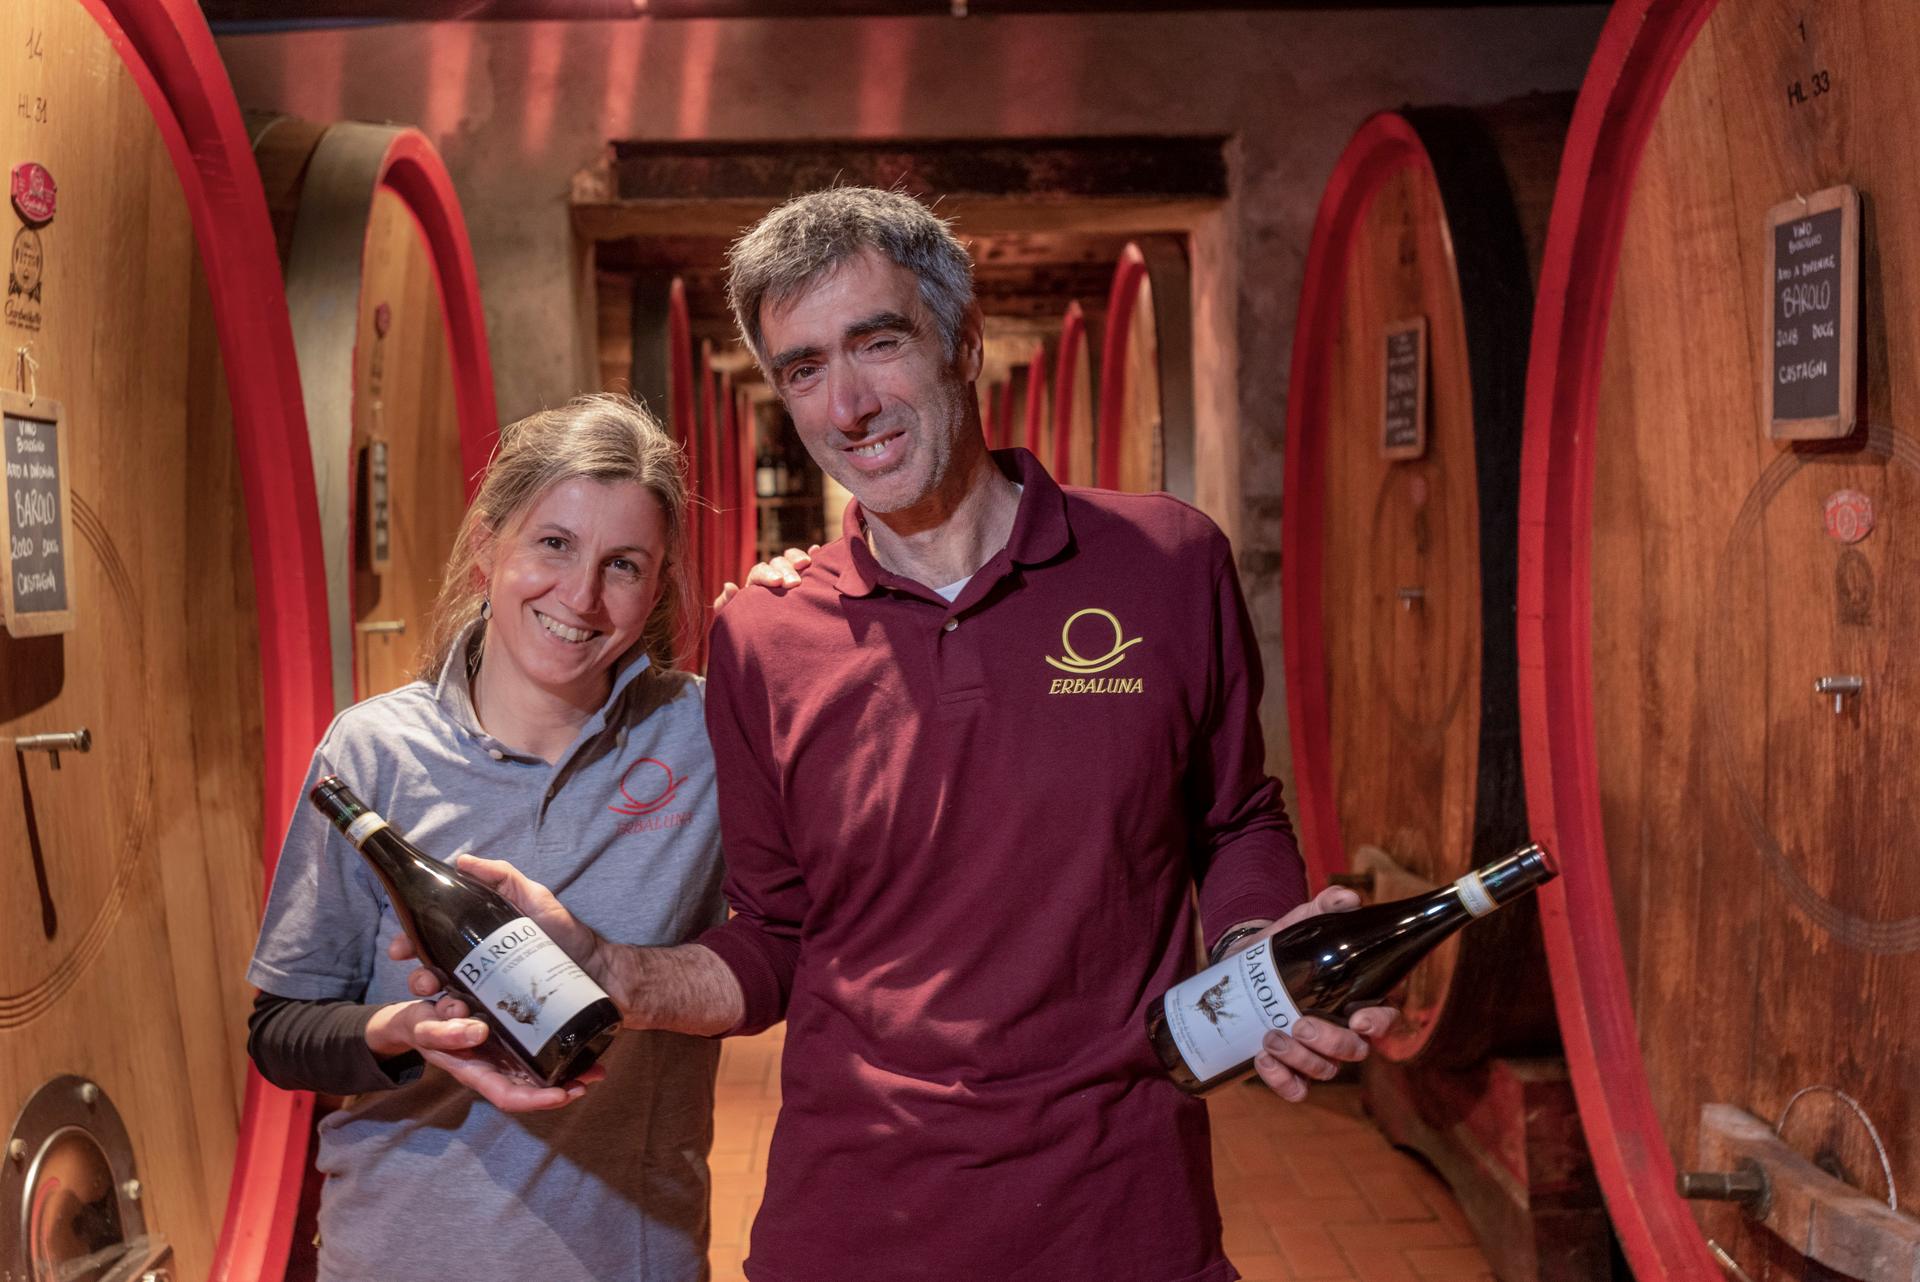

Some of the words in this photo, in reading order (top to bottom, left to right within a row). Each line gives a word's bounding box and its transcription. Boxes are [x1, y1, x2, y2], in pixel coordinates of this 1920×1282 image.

[26, 27, 43, 61] 14
[1787, 81, 1808, 108] HL
[1811, 70, 1830, 97] 33
[18, 93, 31, 119] HL
[35, 97, 47, 123] 31
[1782, 281, 1830, 318] BAROLO
[1812, 321, 1834, 340] DOCG
[1779, 359, 1827, 384] CASTAGNI
[15, 489, 55, 528] BAROLO
[1048, 678, 1144, 695] ERBALUNA
[460, 925, 537, 986] BAROLO
[1246, 944, 1289, 1029] BAROLO
